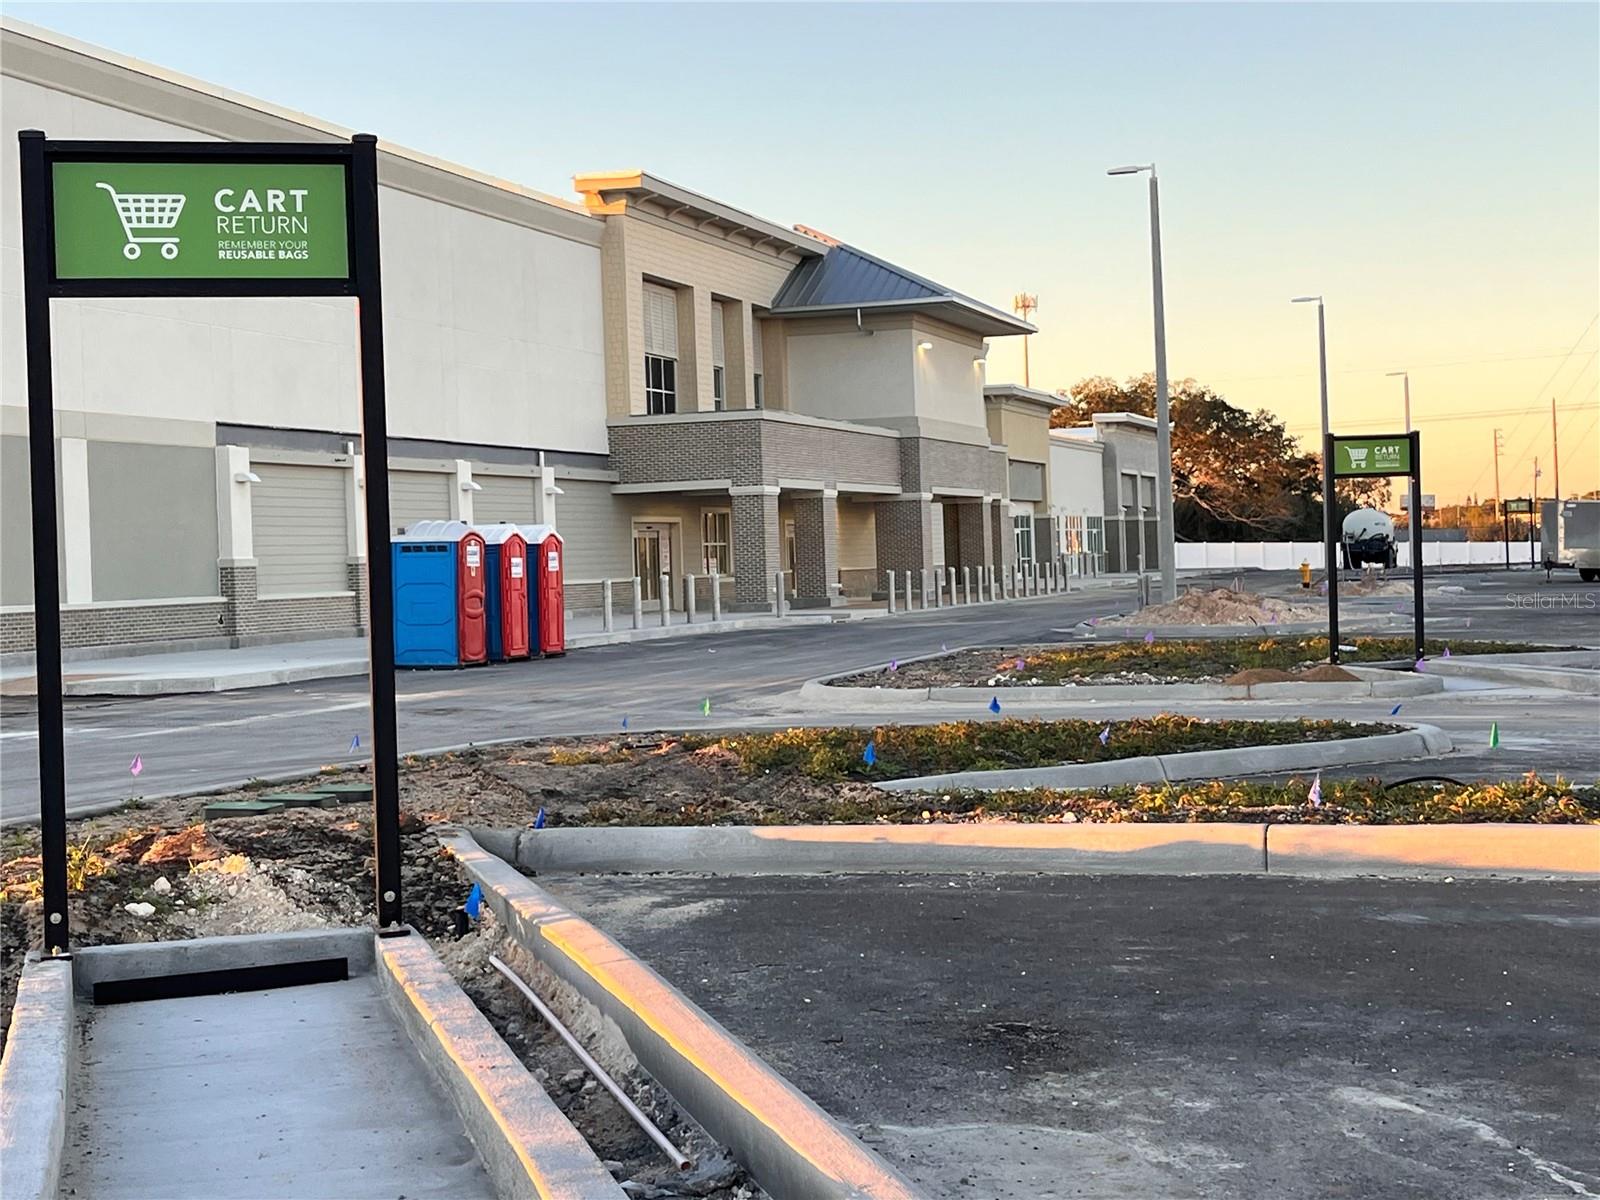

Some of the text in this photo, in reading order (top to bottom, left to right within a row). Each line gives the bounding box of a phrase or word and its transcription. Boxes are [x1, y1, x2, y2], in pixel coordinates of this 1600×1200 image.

[214, 188, 308, 213] CART
[217, 215, 308, 234] RETURN
[218, 240, 308, 250] REMEMBER YOUR
[218, 250, 309, 260] REUSABLE BAGS
[1374, 445, 1400, 455] CART
